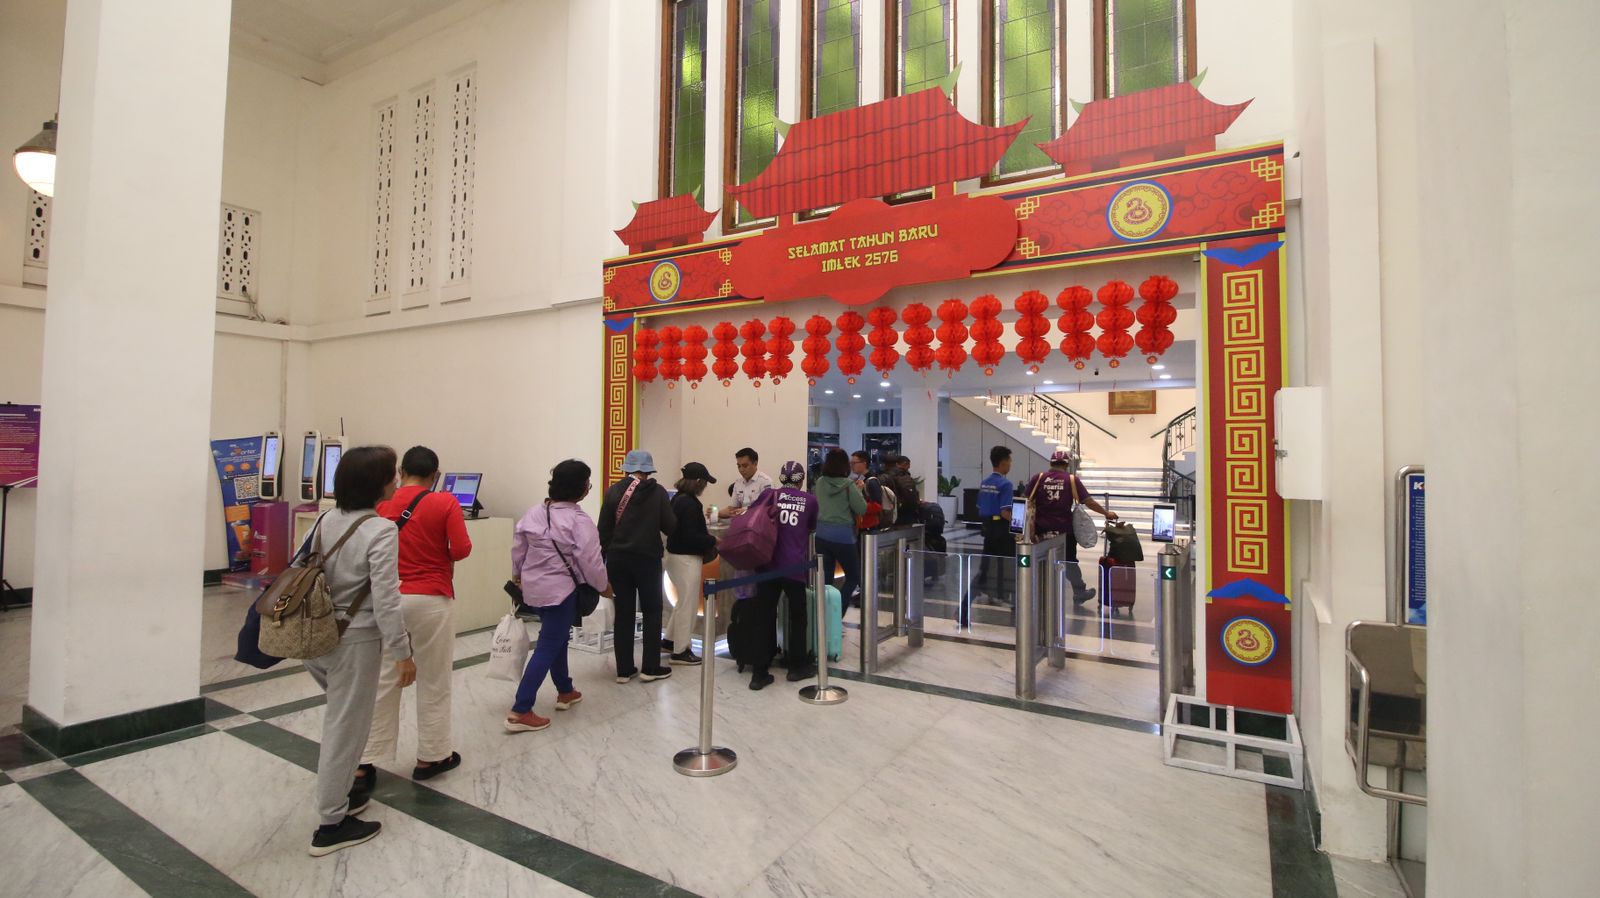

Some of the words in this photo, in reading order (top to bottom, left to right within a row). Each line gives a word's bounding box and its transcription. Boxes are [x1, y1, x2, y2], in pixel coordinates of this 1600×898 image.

[788, 239, 846, 260] SELAMAT
[850, 231, 895, 250] TAHUN
[898, 223, 939, 242] BARU
[821, 255, 861, 273] IMLEK
[864, 249, 899, 267] 2576
[1047, 490, 1060, 500] 34
[780, 509, 799, 526] 06
